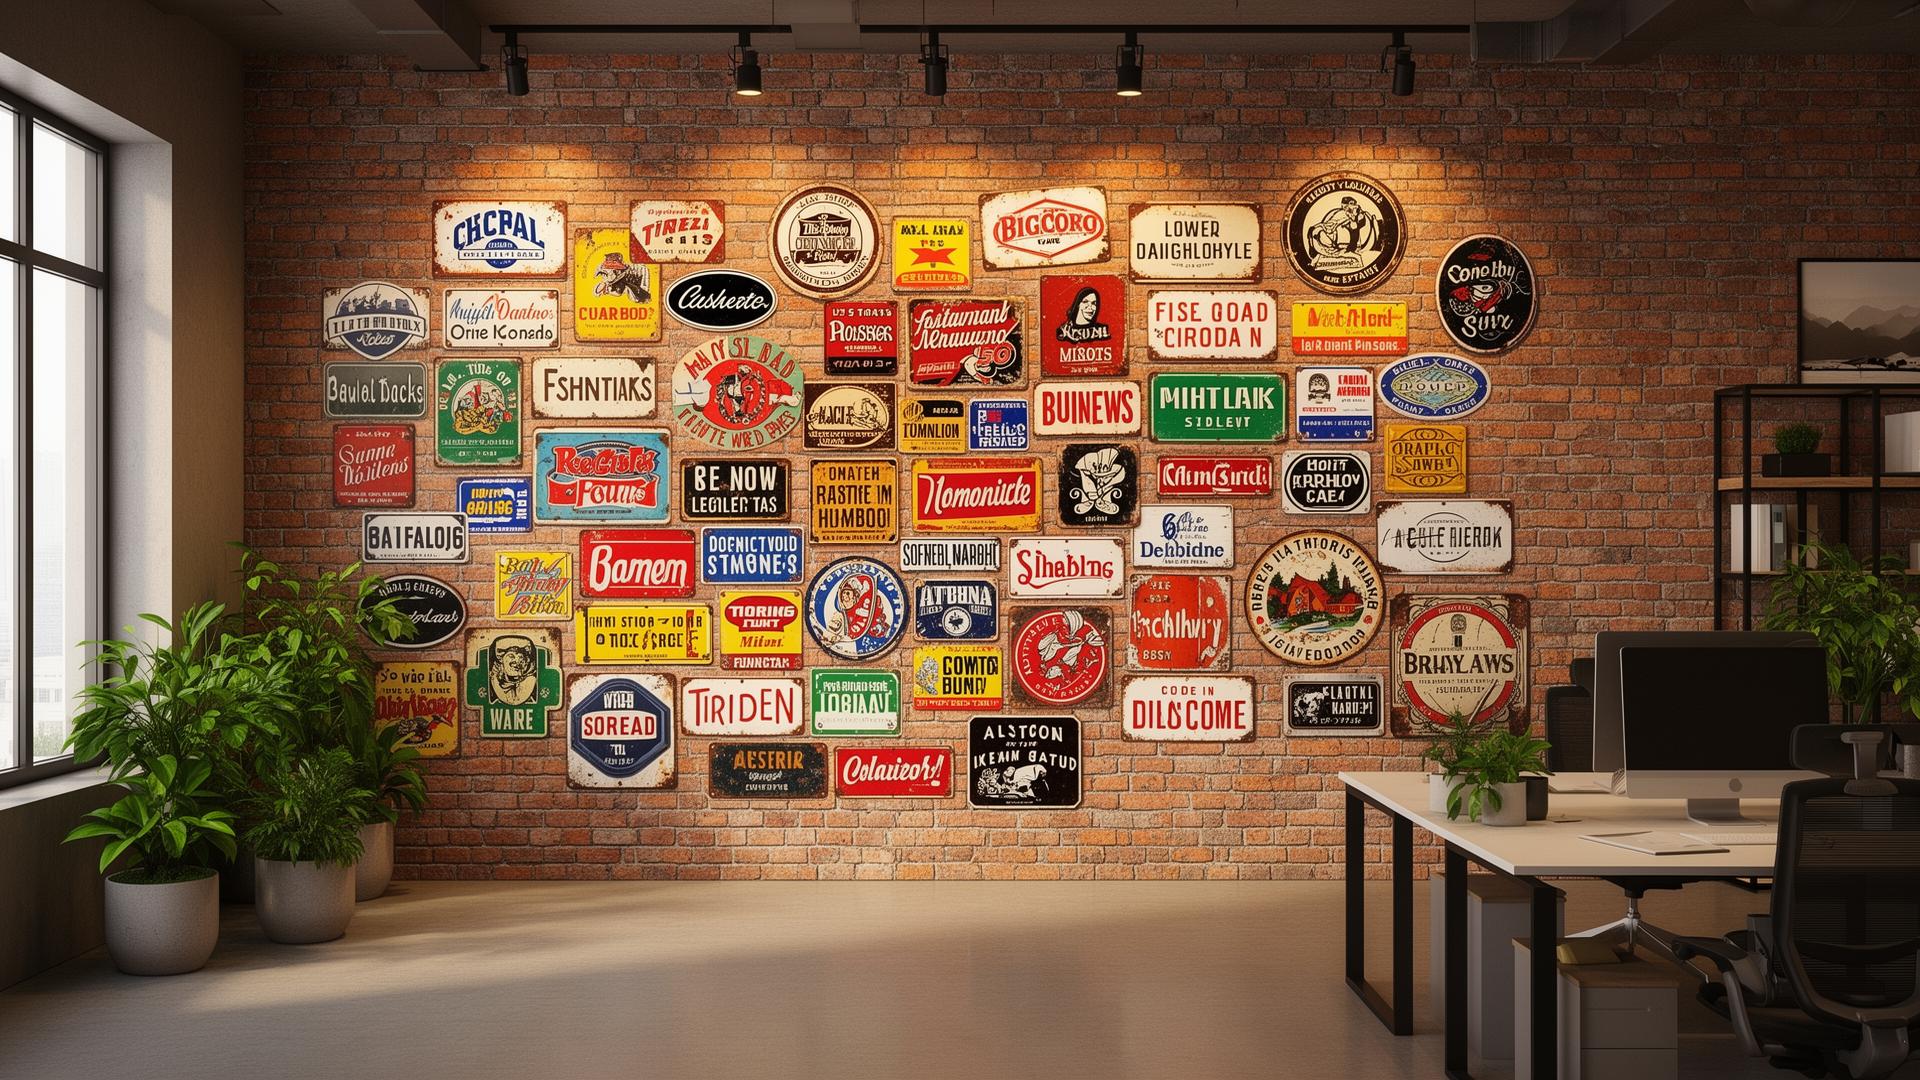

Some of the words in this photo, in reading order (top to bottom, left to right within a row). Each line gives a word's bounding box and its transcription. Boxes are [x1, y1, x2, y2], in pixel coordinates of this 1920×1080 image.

[1164, 220, 1219, 238] LOWER
[1156, 302, 1203, 322] FISE
[730, 466, 777, 492] NOW
[1161, 685, 1196, 696] CODE
[1203, 686, 1214, 696] IN
[490, 708, 533, 731] WARE
[584, 715, 656, 737] SOREAD
